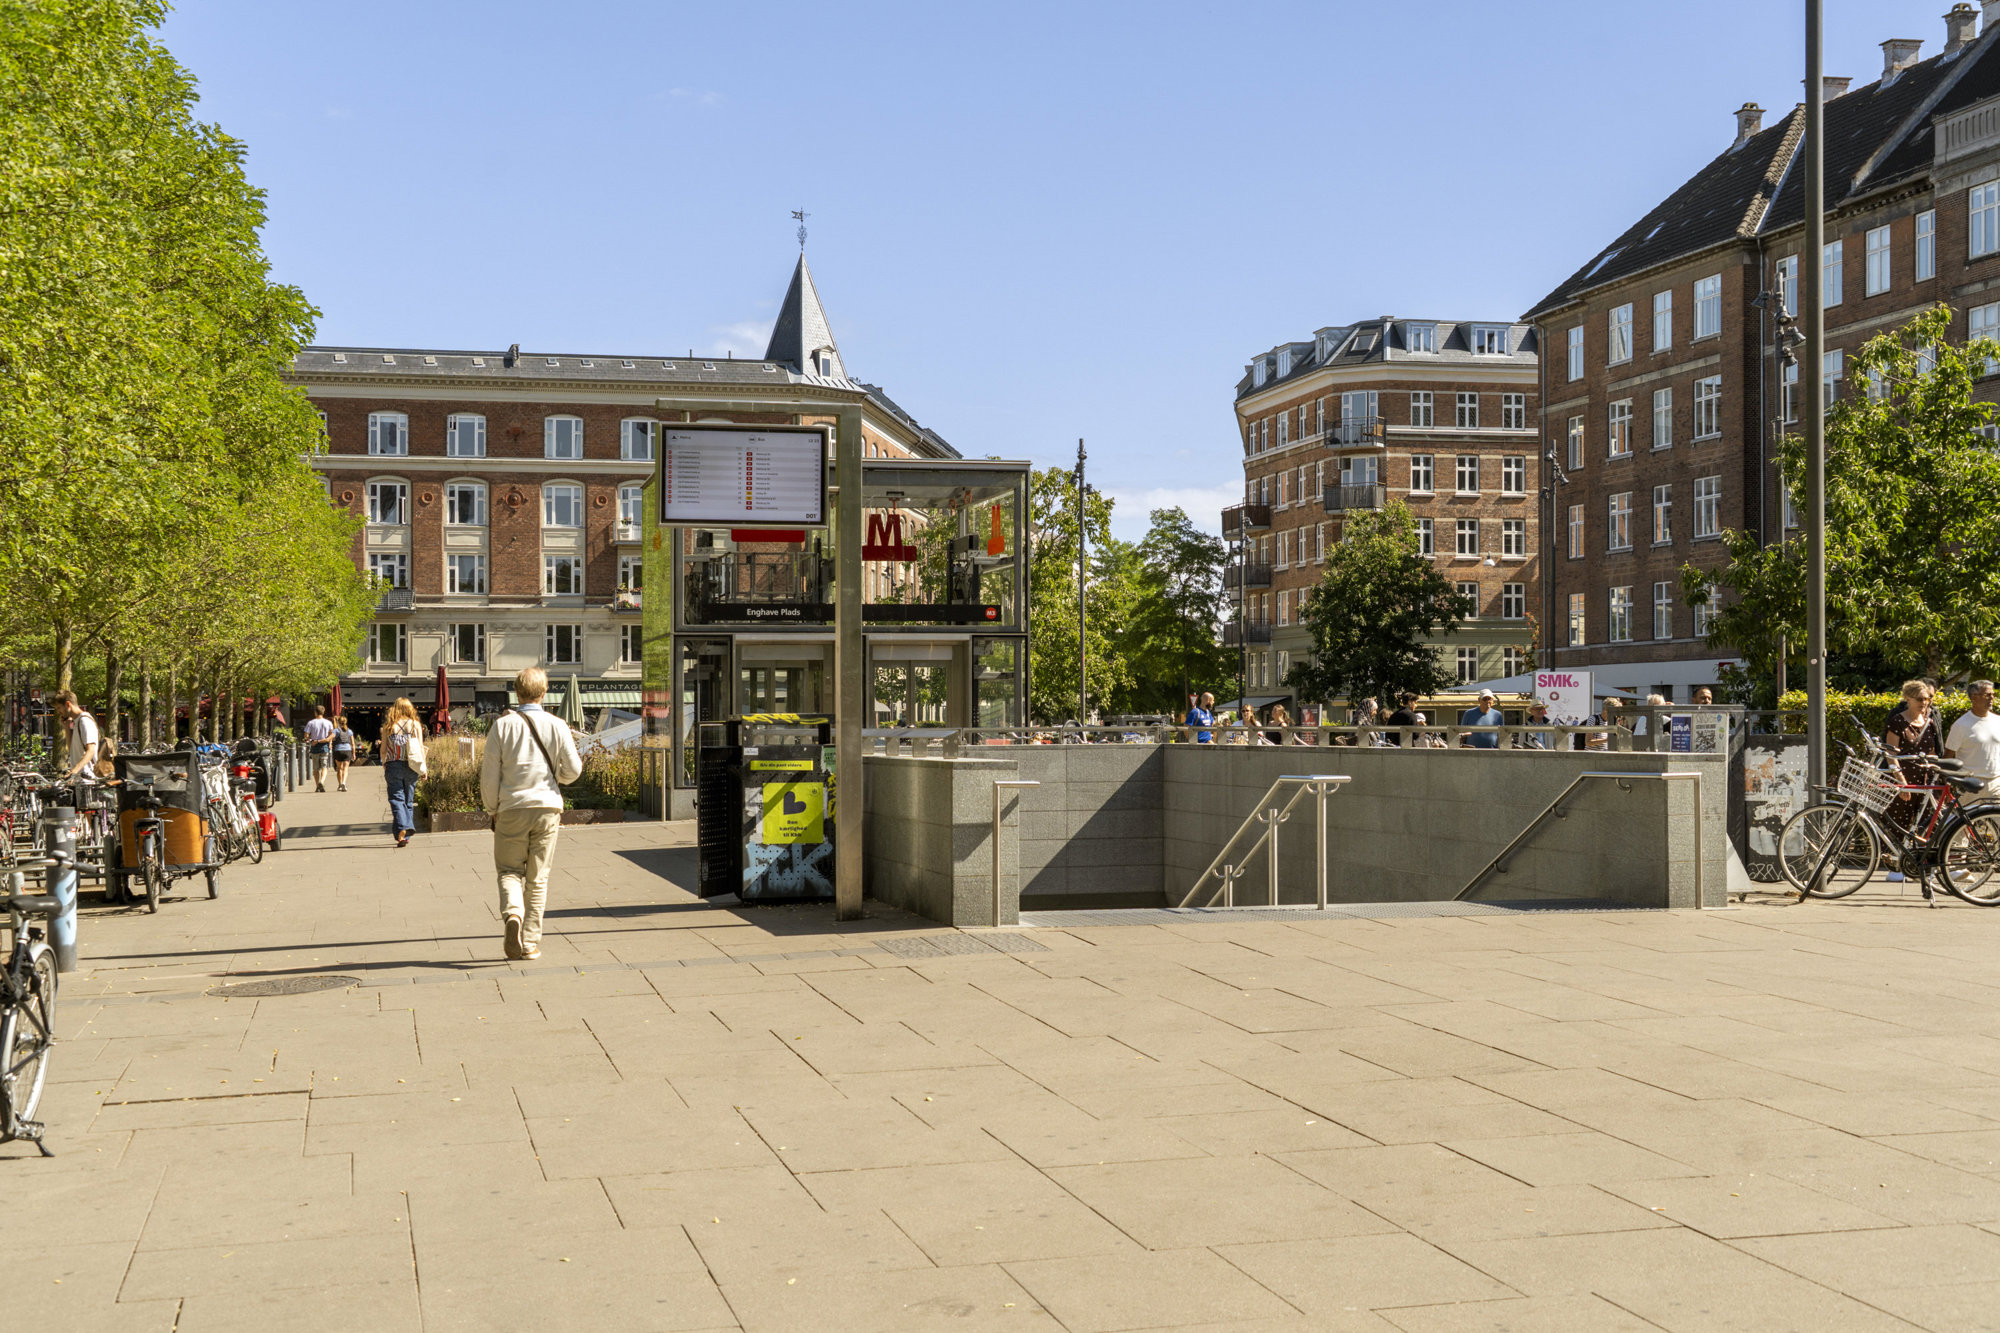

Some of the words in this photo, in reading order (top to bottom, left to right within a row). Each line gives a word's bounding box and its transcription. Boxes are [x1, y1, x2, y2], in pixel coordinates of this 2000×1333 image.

[746, 608, 779, 617] Enghave
[781, 608, 801, 616] Plads
[1537, 674, 1573, 688] SMK
